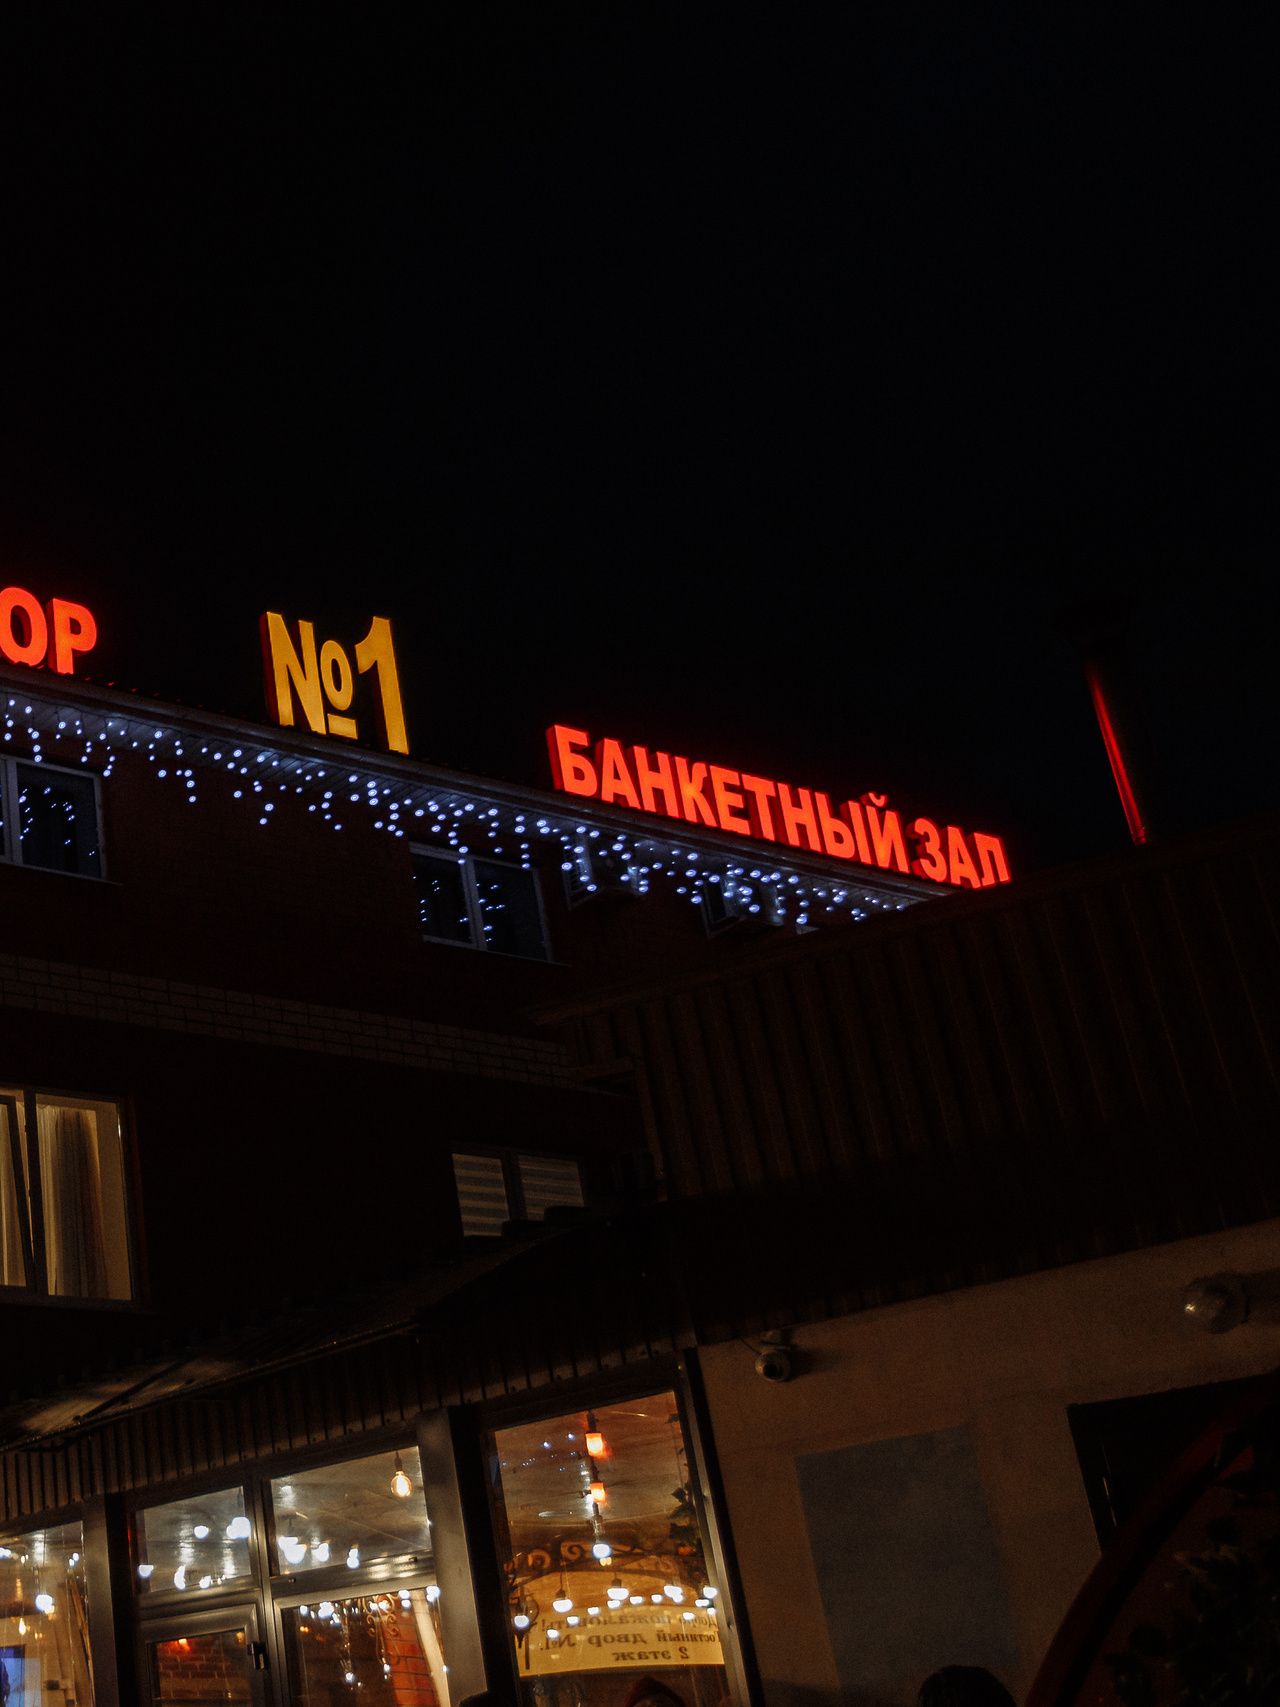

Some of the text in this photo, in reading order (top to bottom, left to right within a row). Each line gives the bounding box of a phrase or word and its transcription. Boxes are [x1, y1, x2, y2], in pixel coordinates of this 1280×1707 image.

[265, 611, 409, 755] №1
[549, 725, 1011, 889] БАНКЕТНЫЙ ЗАЛ
